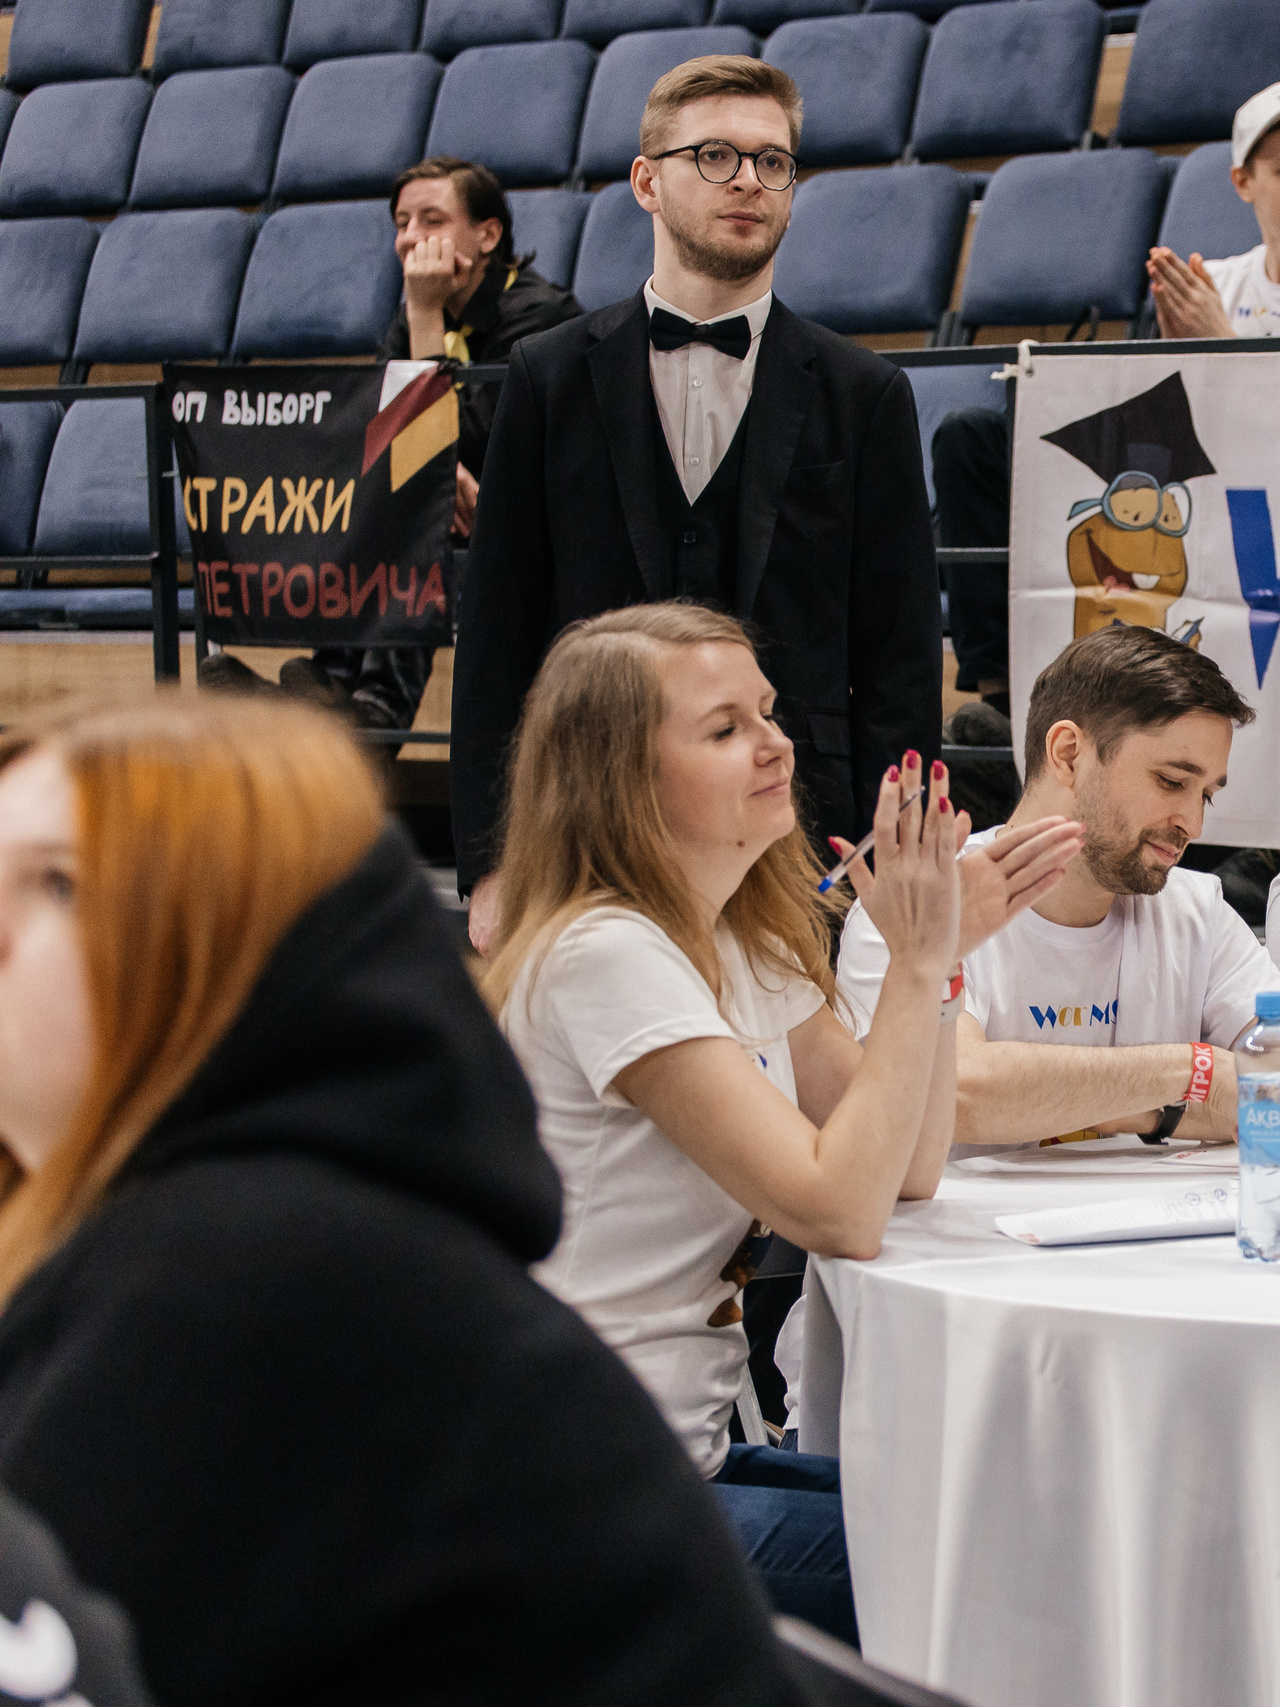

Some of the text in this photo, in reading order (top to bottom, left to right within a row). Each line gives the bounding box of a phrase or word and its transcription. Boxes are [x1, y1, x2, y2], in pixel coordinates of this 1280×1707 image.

[221, 389, 332, 426] ВЫБОРГ
[197, 561, 447, 619] ПЕТРОВИЧА
[1189, 1044, 1212, 1103] ИГРОК
